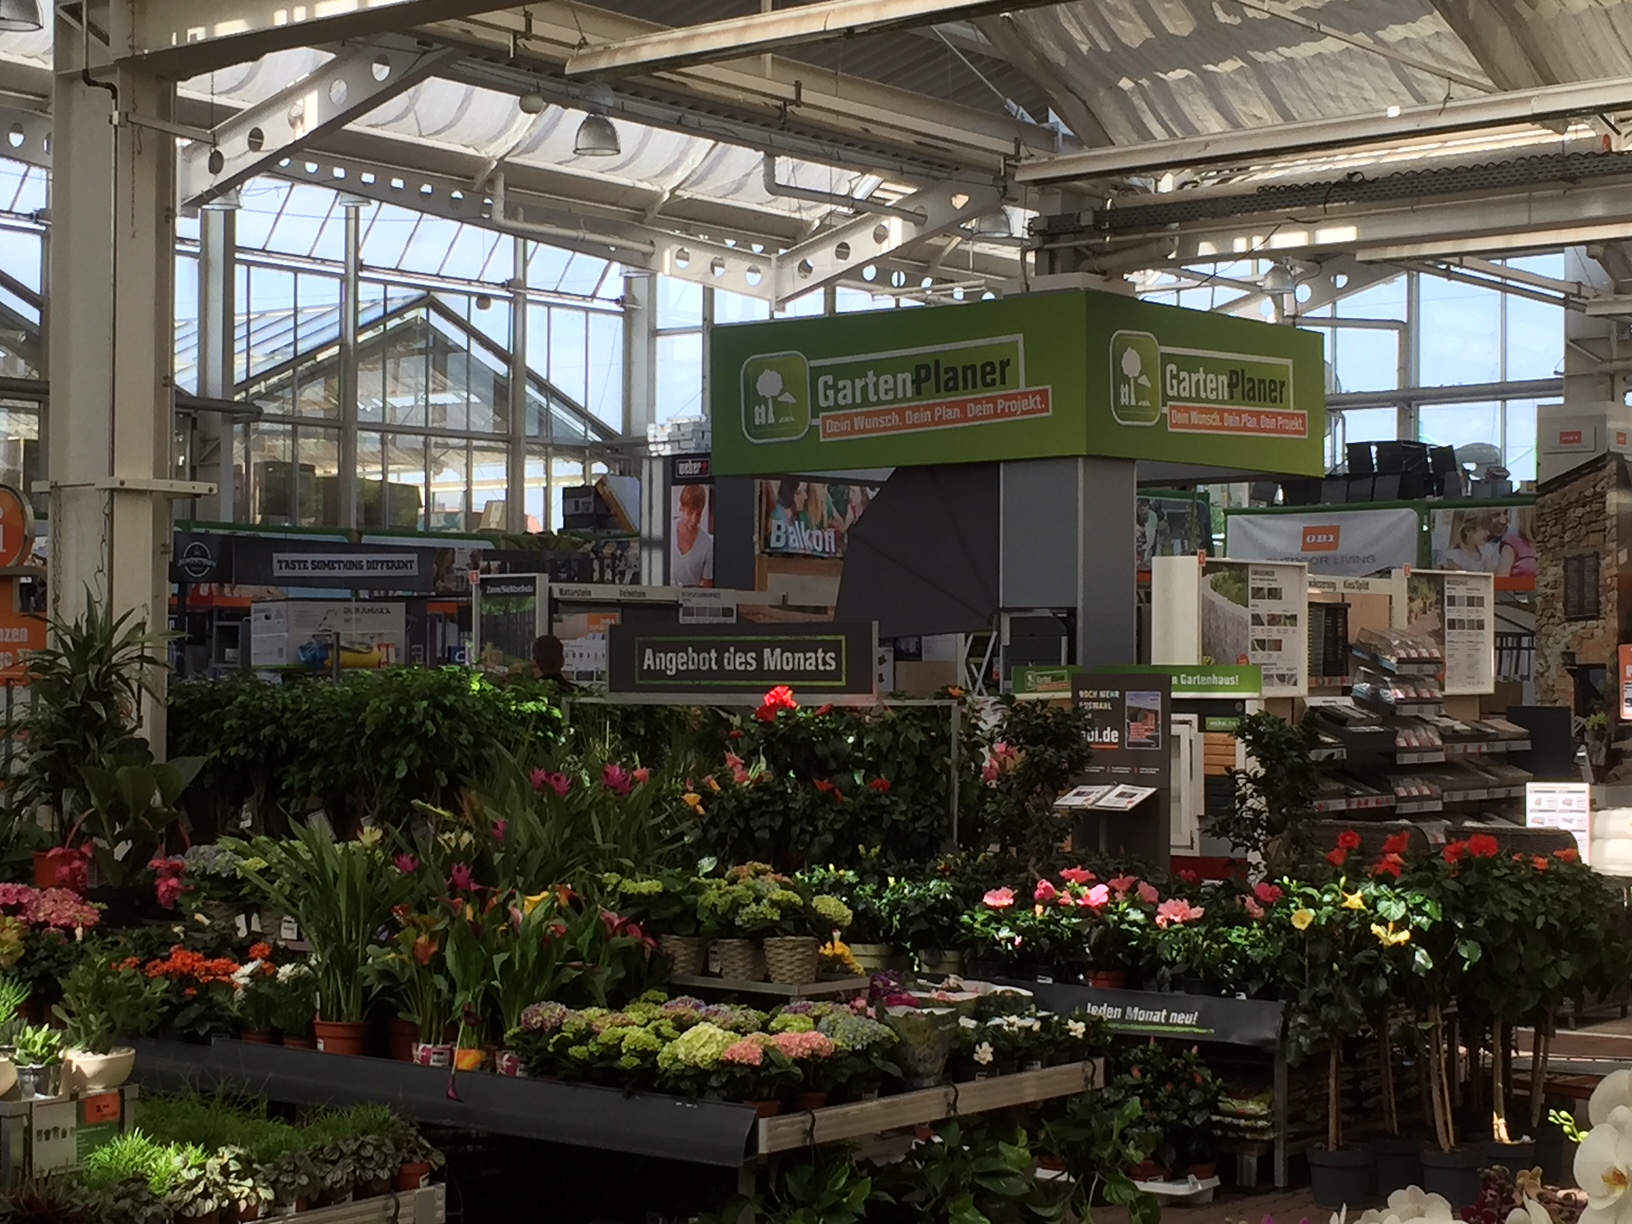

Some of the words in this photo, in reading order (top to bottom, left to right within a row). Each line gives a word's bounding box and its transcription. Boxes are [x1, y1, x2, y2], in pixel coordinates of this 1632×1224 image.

[826, 415, 852, 433] Dein
[854, 410, 902, 431] Wunsch.
[906, 406, 932, 424] Dein
[934, 402, 963, 422] Plan.
[967, 399, 994, 418] Dein
[996, 394, 1045, 416] Projekt.
[1172, 410, 1188, 426] Dein
[1261, 414, 1277, 430] Dein
[1278, 414, 1304, 432] Projekt.
[770, 519, 836, 553] Balkon
[1306, 534, 1335, 544] OBI
[276, 558, 310, 570] TASTE
[311, 559, 364, 570] SOMETHING
[366, 559, 414, 570] DIFFERENT
[1334, 554, 1376, 565] LIVING
[644, 647, 719, 677] Angebot
[724, 646, 758, 672] des
[764, 647, 838, 672] Monats
[1180, 674, 1239, 686] Gartenhaus!
[1125, 1006, 1168, 1023] Monat
[1169, 1011, 1199, 1024] neu!
